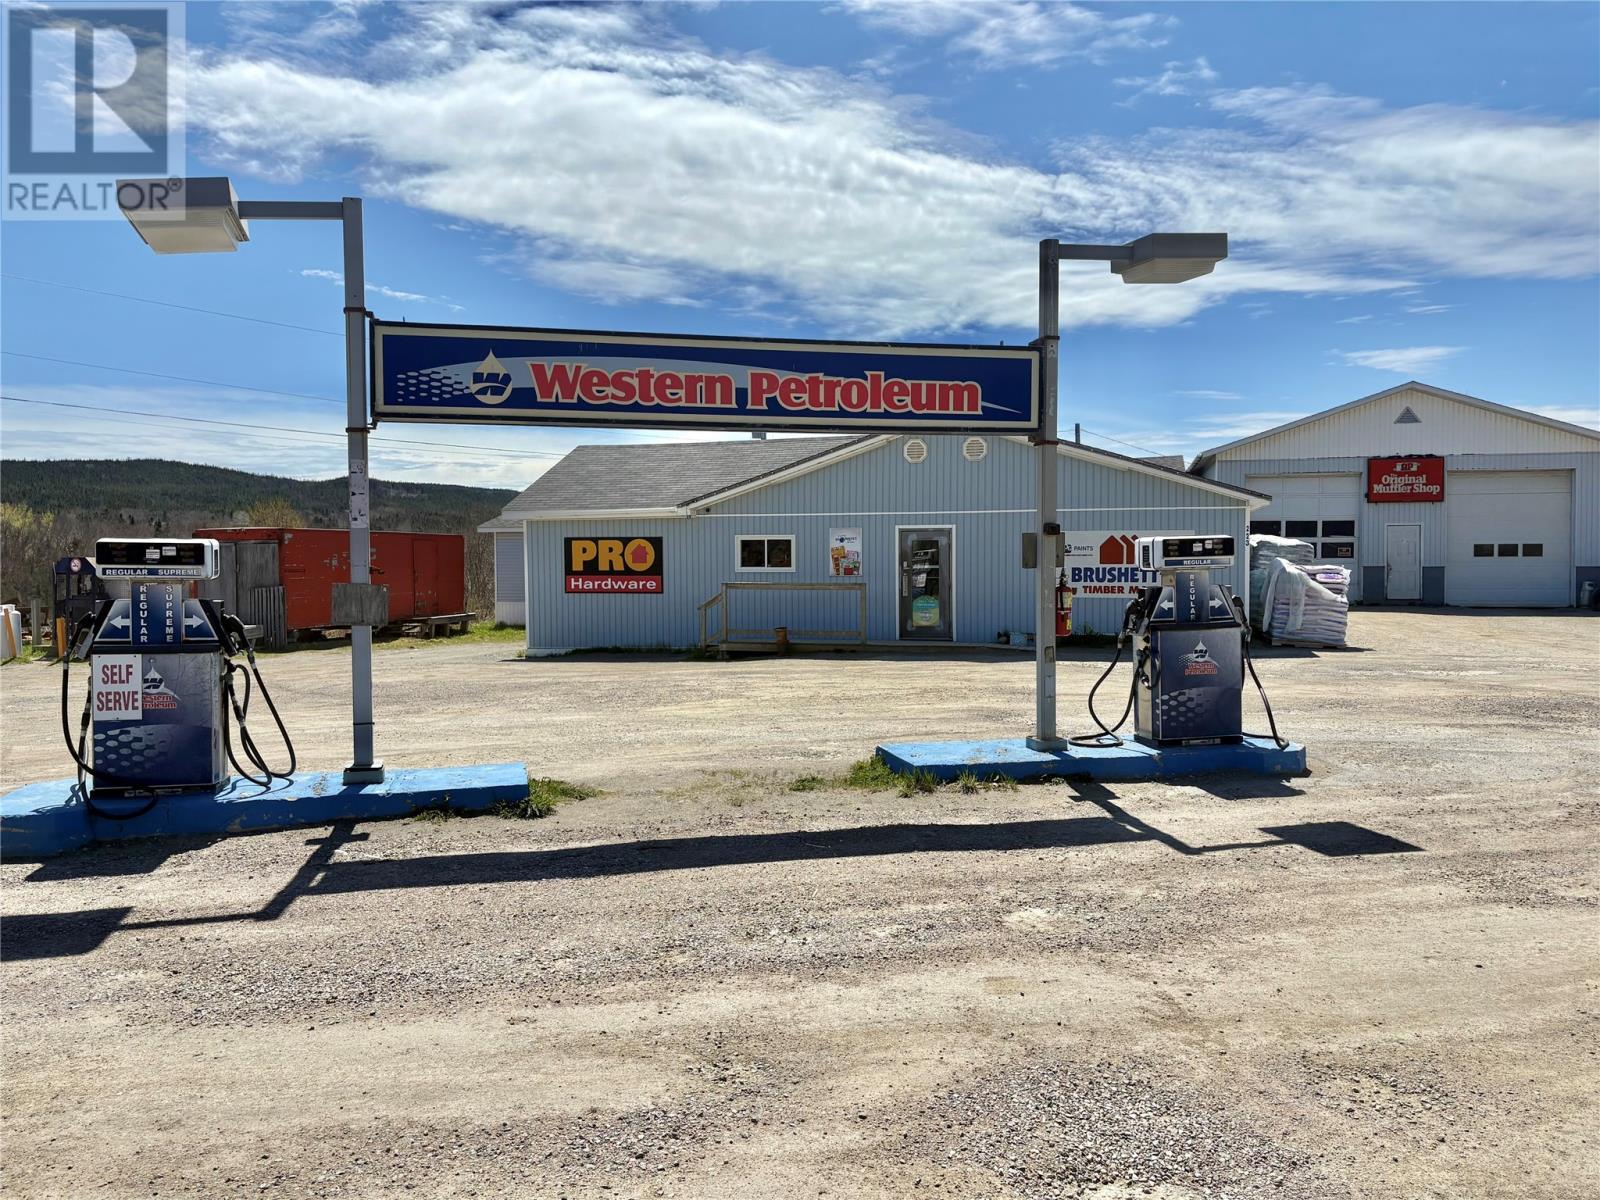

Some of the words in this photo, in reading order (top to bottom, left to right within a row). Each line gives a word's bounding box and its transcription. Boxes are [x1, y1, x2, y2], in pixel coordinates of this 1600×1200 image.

[527, 361, 738, 407] Western
[746, 370, 983, 415] Petroleum
[1373, 483, 1412, 493] Muffler
[1413, 483, 1440, 495] Shop
[1381, 474, 1426, 485] Original
[571, 538, 655, 572] PRO
[571, 578, 656, 590] Hardware
[1082, 585, 1125, 594] TIMBER
[140, 585, 148, 643] REGULAR
[165, 584, 174, 643] SUPREME
[101, 664, 133, 685] SELF
[96, 691, 140, 712] SERVE
